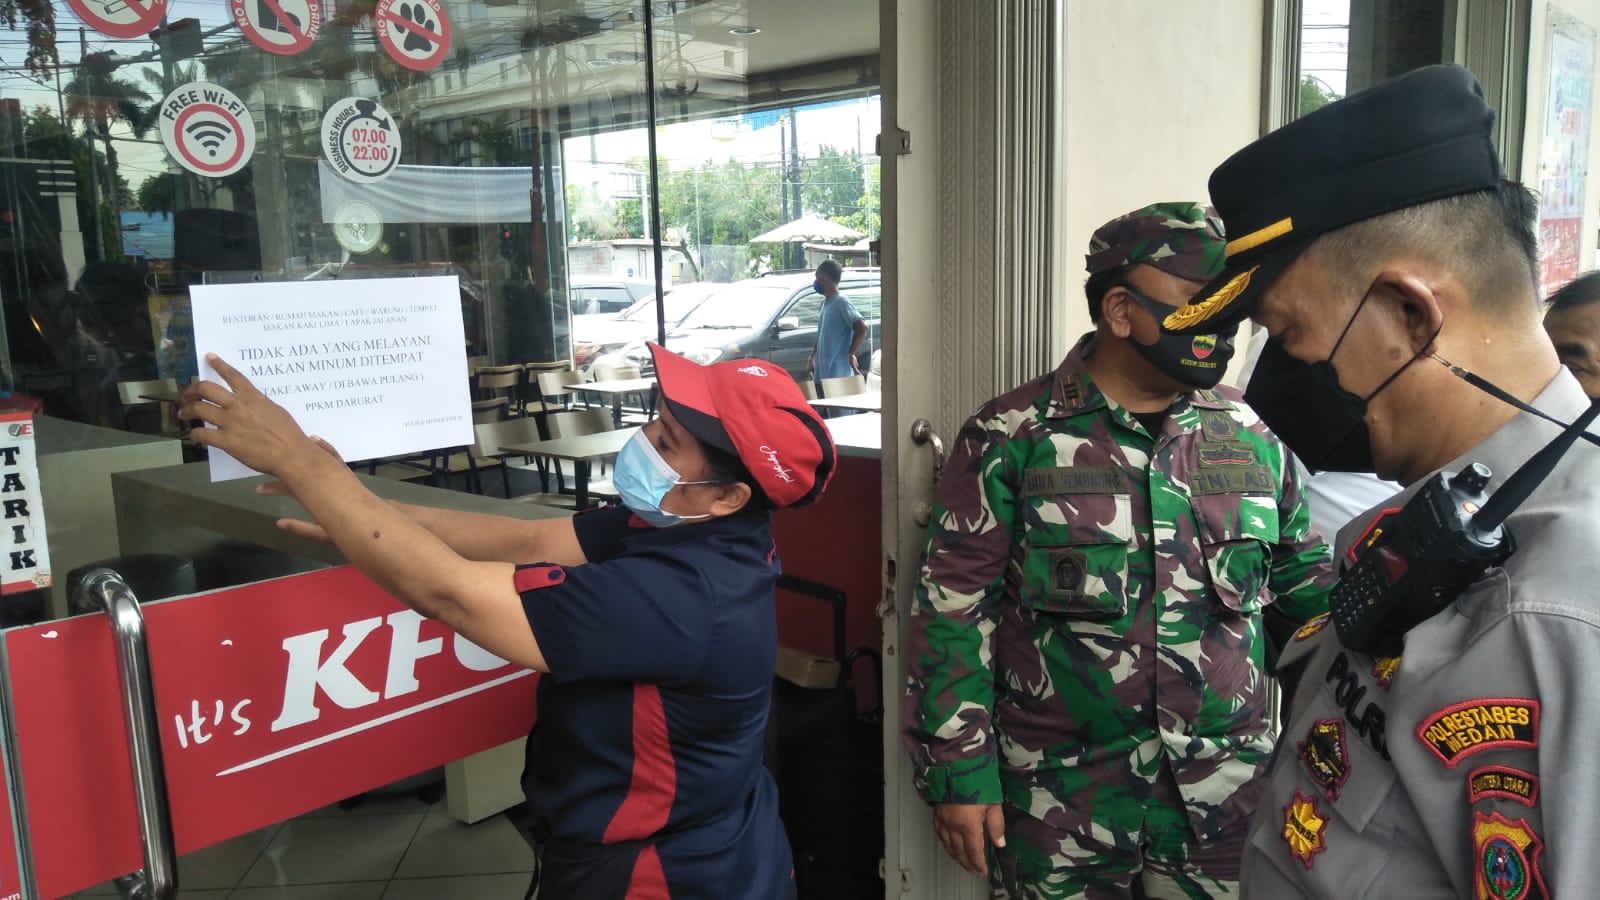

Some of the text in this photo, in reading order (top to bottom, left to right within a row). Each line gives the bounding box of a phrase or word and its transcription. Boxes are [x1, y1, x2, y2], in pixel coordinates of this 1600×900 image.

[309, 4, 321, 40] DRINK
[162, 89, 246, 121] FREE Wi-Fi
[328, 105, 357, 174] BUSINESS HOURS
[352, 127, 387, 144] 07.00
[352, 145, 389, 161] 22.00
[239, 335, 432, 361] TIDAK ADA YANG MELAYANI
[250, 351, 424, 377] MAKAN MINUM DITEMPAT
[295, 381, 327, 394] AWAY
[380, 373, 419, 386] PULANG
[305, 394, 384, 412] PPKM DARURAT
[0, 446, 37, 571] TARIK
[174, 699, 252, 749] It's
[1425, 705, 1530, 746] POLRESTABES
[1446, 724, 1516, 753] MEDAN
